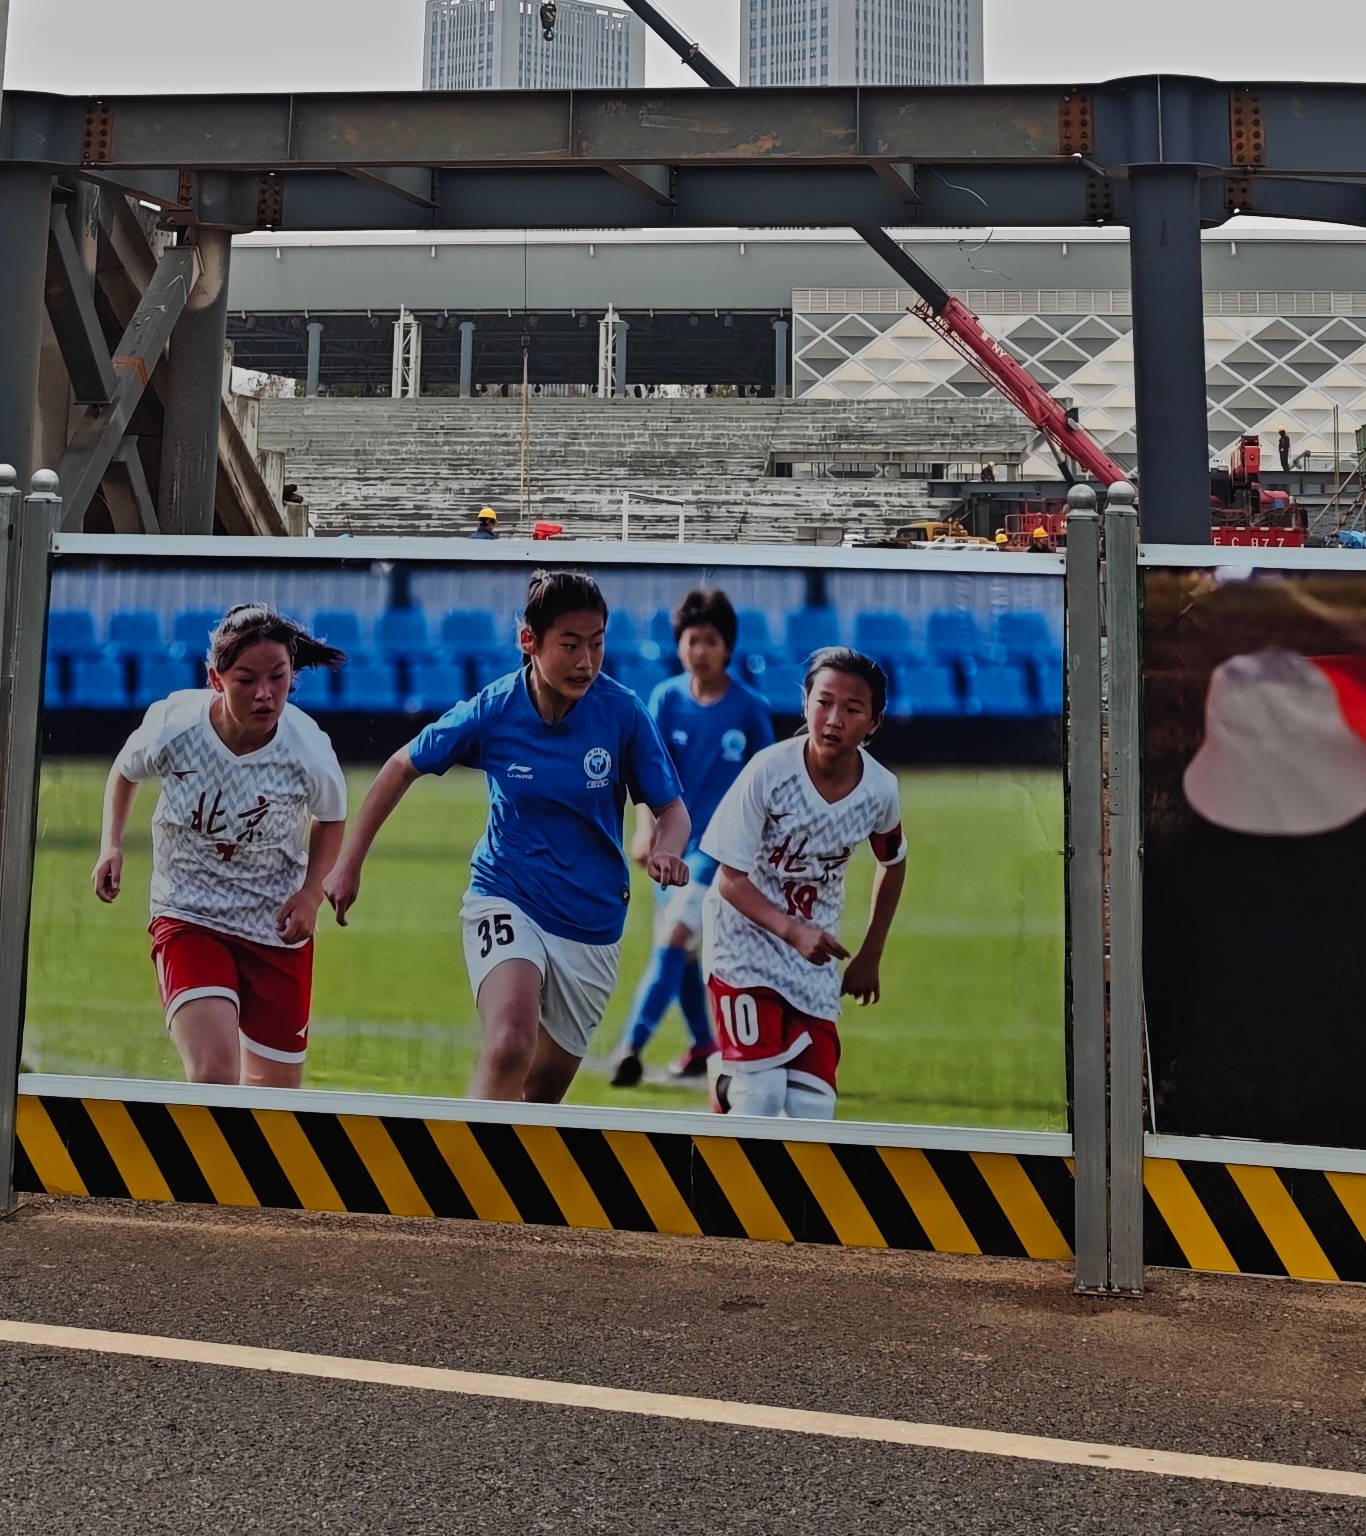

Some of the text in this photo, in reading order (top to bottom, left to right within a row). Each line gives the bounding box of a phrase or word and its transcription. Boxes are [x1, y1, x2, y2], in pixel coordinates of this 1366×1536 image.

[191, 789, 270, 843] 北京
[768, 835, 852, 884] 北京
[477, 913, 515, 959] 35
[720, 993, 760, 1048] 10
